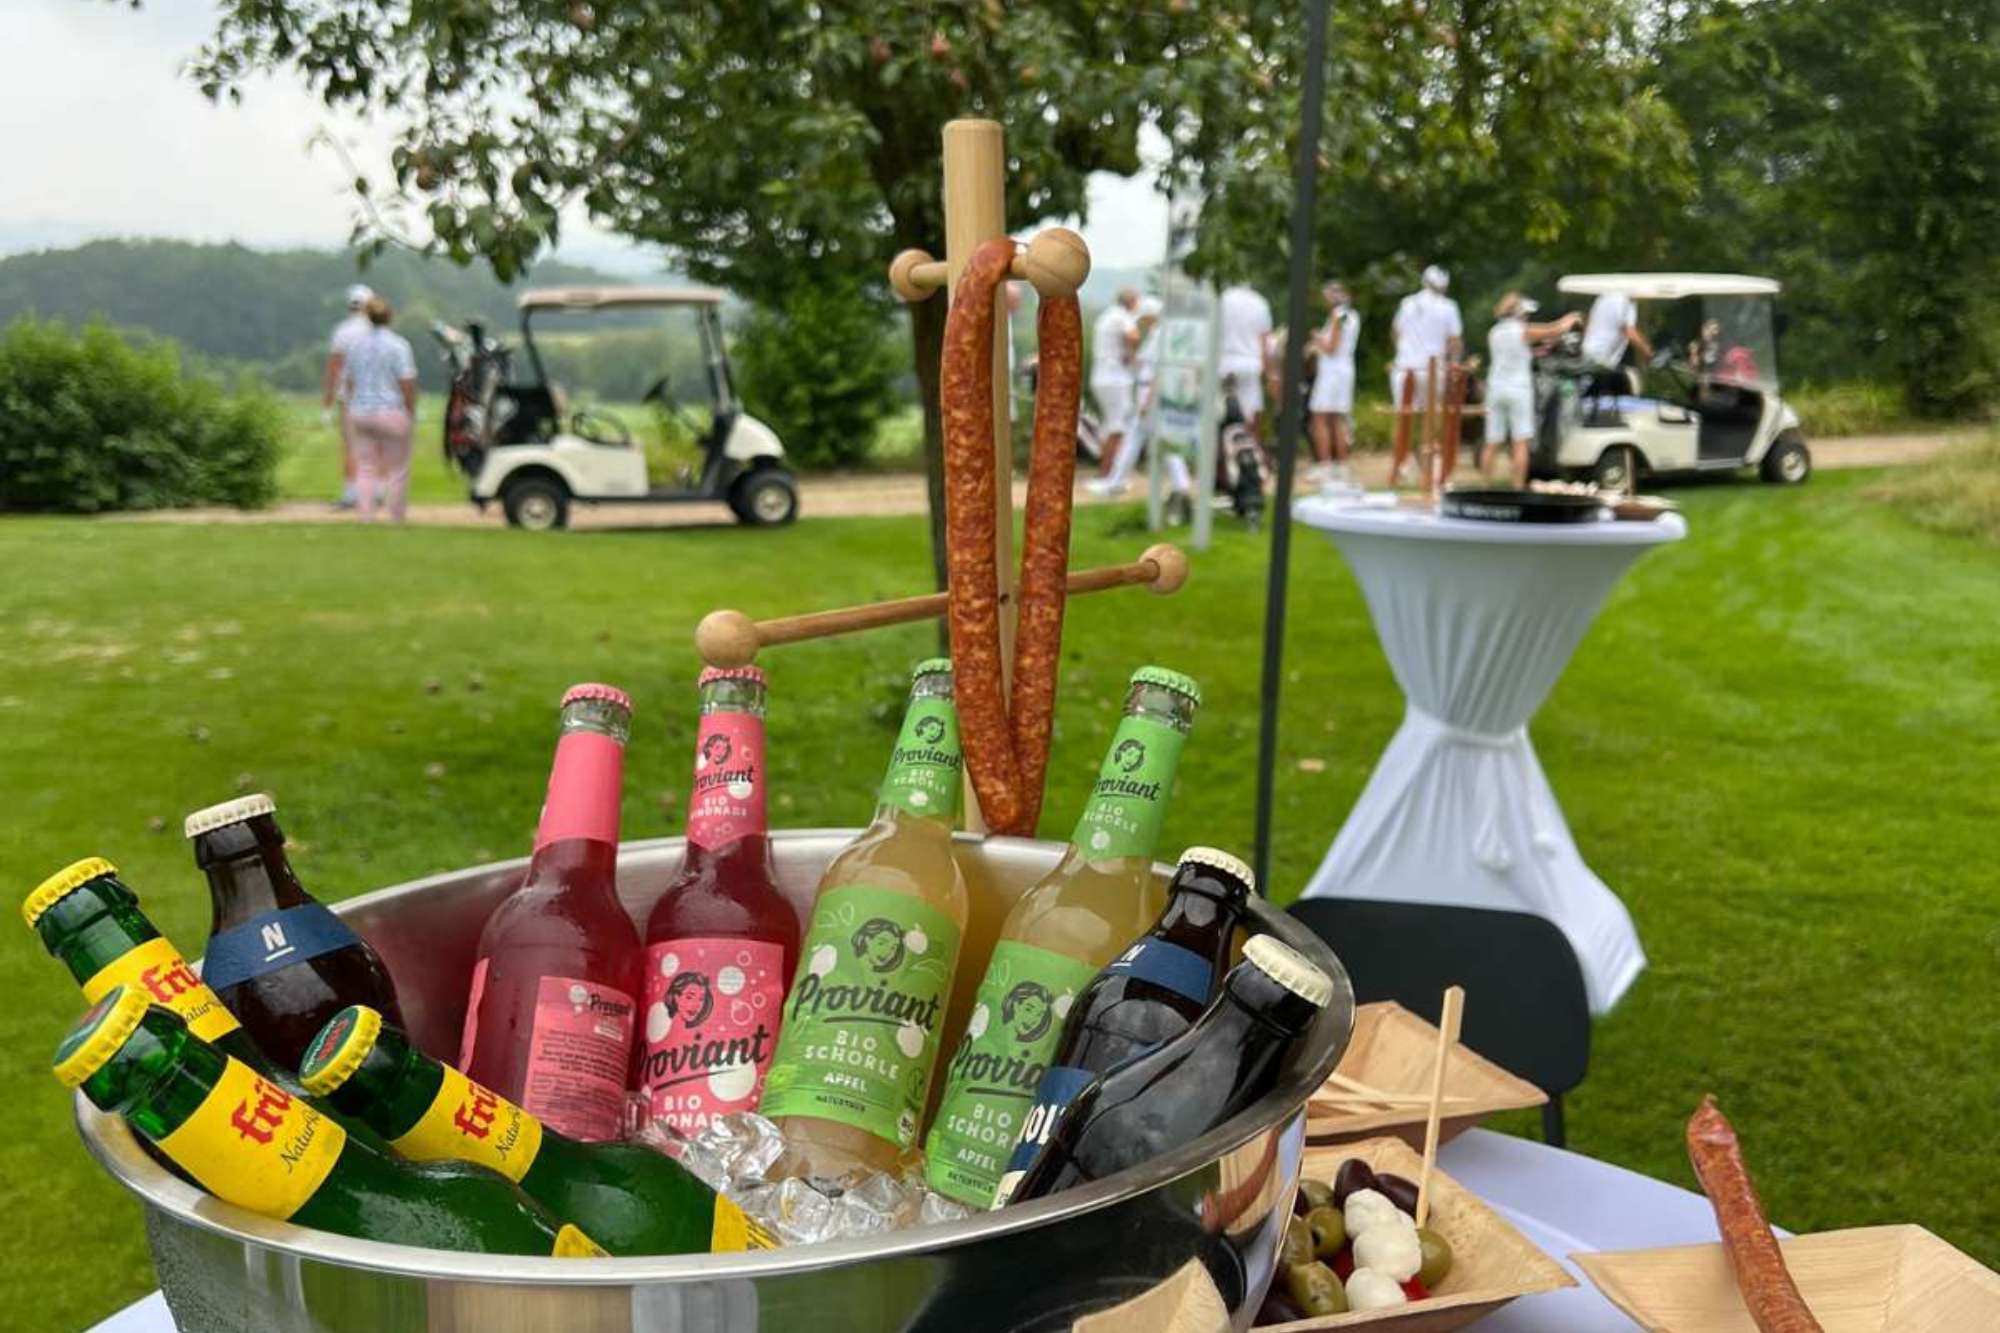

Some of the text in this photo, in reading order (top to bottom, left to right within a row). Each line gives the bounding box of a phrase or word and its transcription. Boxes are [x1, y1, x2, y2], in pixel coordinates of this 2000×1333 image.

[694, 764, 754, 790] roviant
[1096, 775, 1160, 801] roviant
[261, 921, 288, 951] N
[792, 973, 939, 1031] Proviant
[835, 1030, 878, 1051] BIO
[803, 1045, 900, 1080] SCHORLE
[951, 1034, 1045, 1089] Provia
[824, 1072, 867, 1093] APFEL
[664, 1095, 702, 1111] BIO
[972, 1103, 1013, 1128] BIO
[947, 1115, 1010, 1150] SCHOR
[957, 1148, 996, 1171] APFEL
